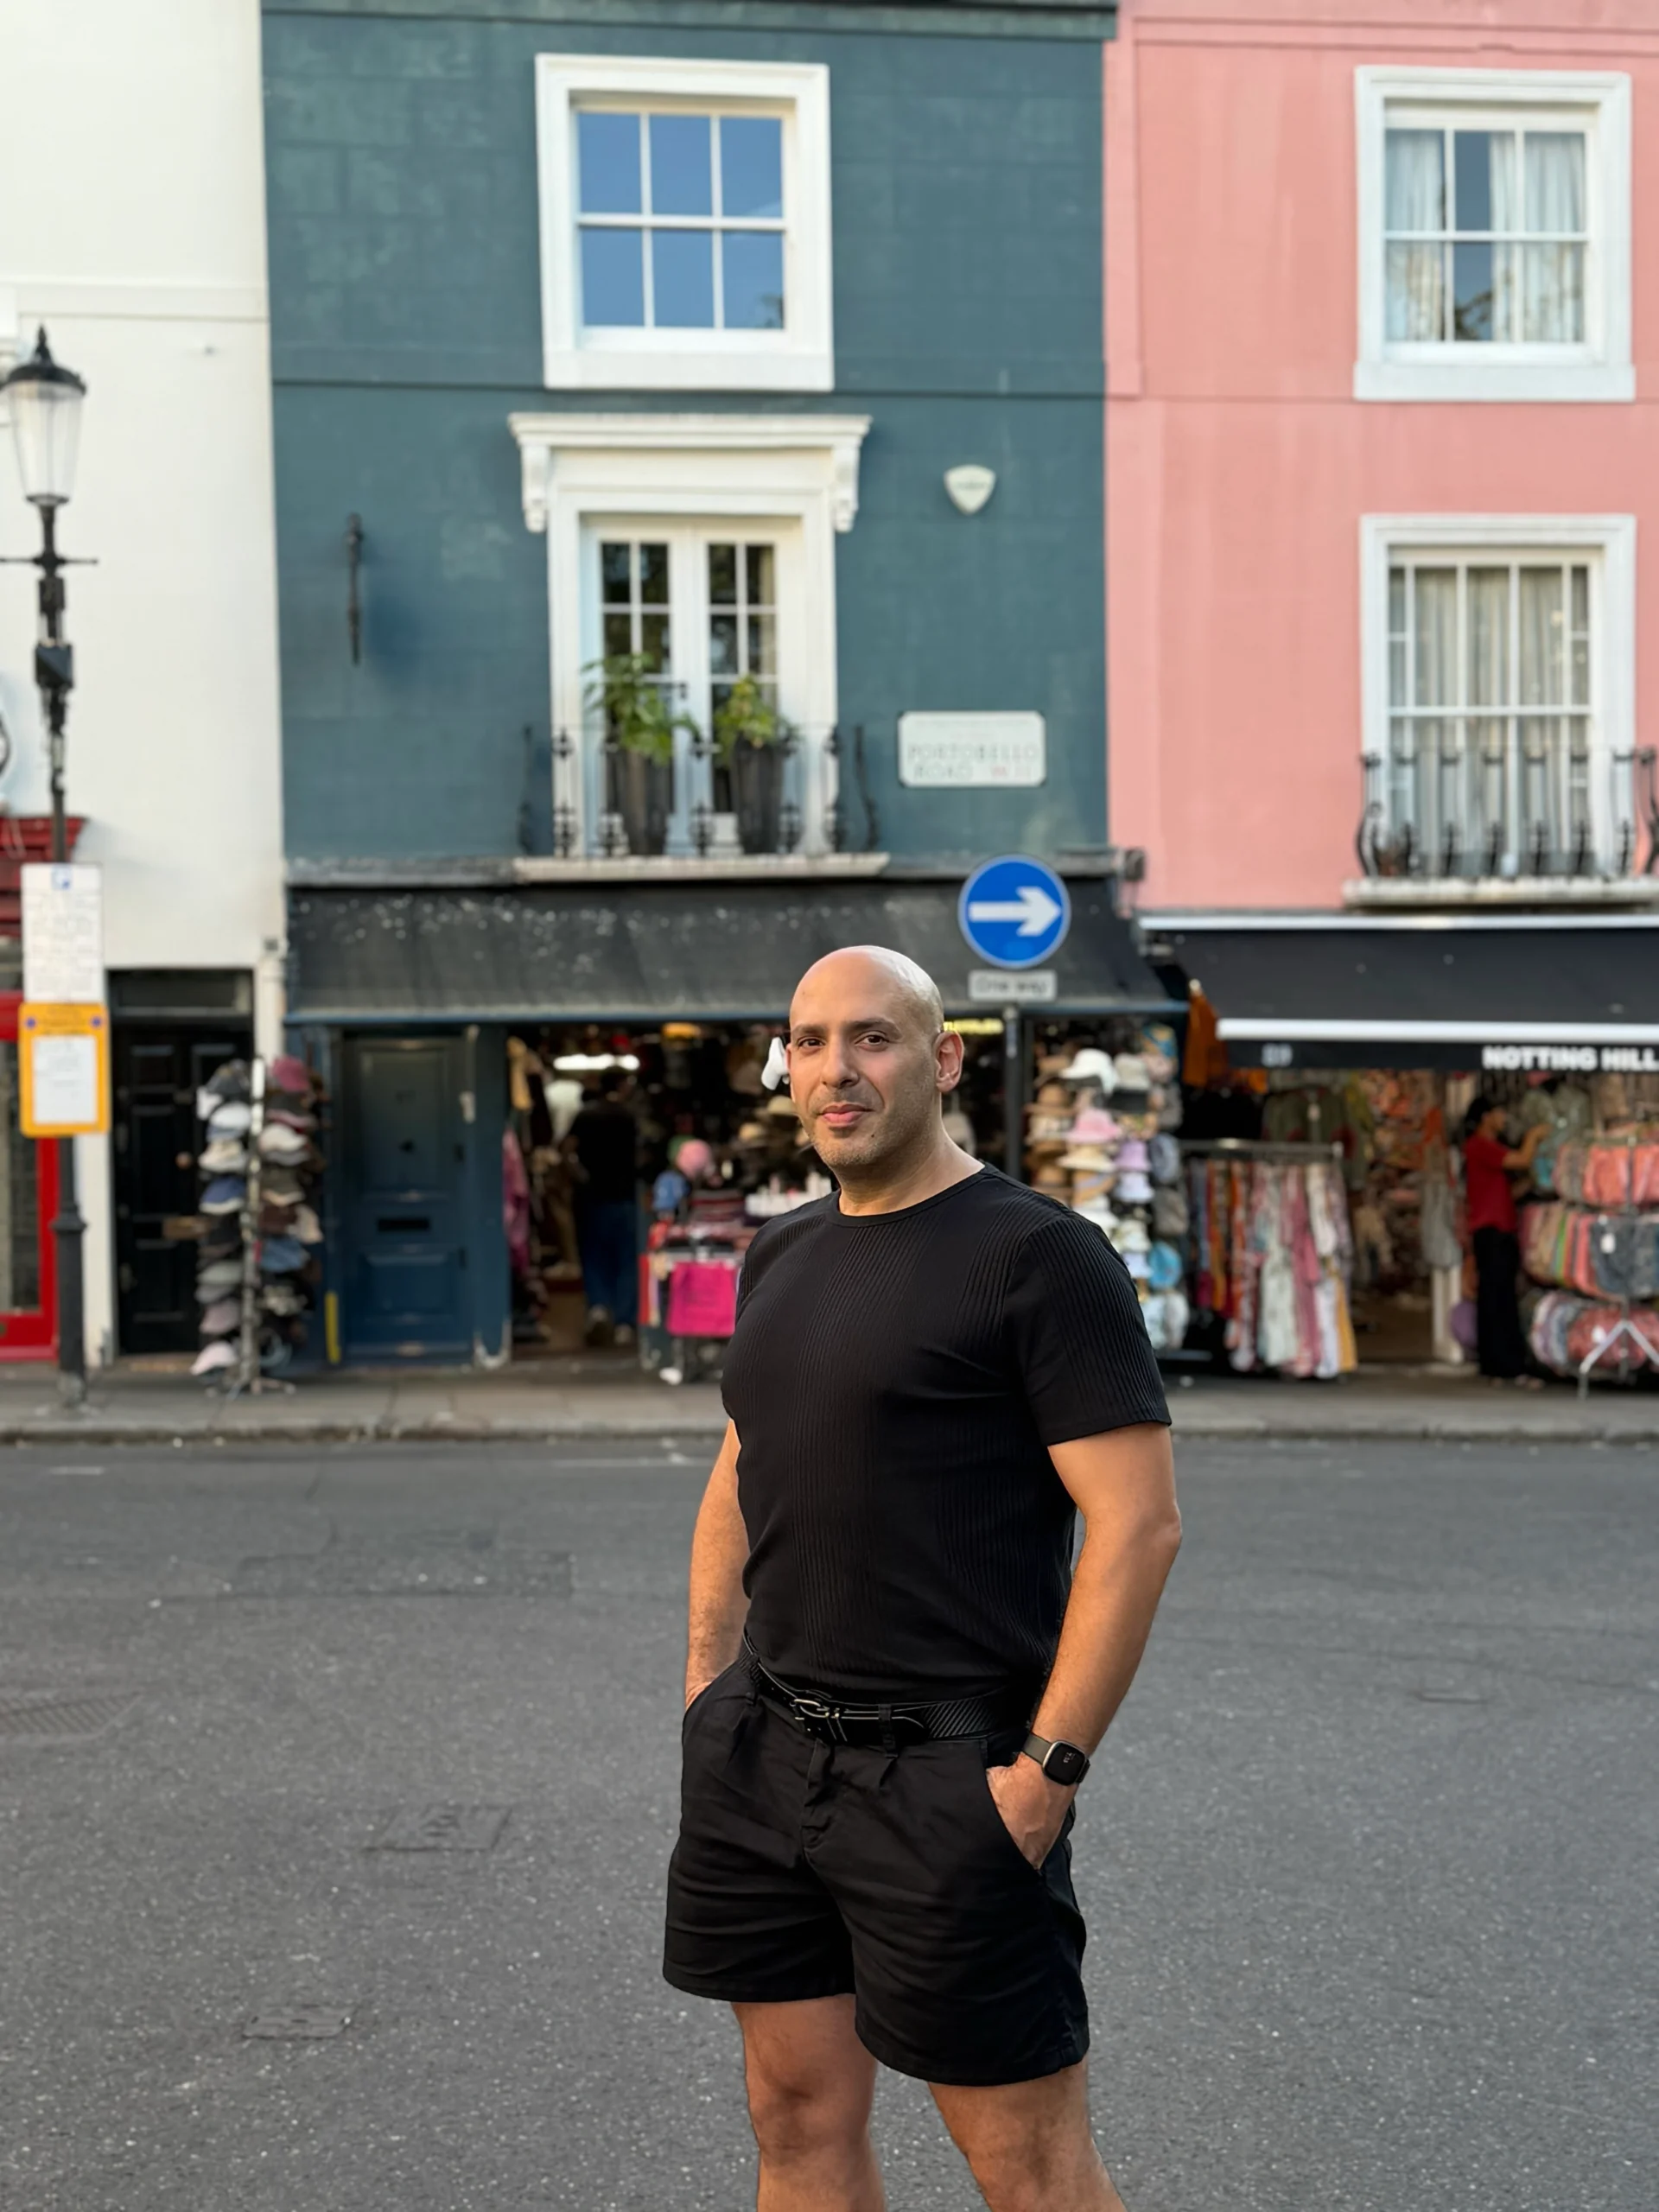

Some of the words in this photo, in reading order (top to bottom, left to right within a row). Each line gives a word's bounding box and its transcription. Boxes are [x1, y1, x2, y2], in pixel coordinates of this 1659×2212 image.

[907, 743, 1039, 762] PORTOBELLO
[976, 976, 1009, 993] One
[1014, 980, 1047, 997] way
[1480, 1045, 1599, 1071] NOTTING
[1600, 1046, 1659, 1071] HILL
